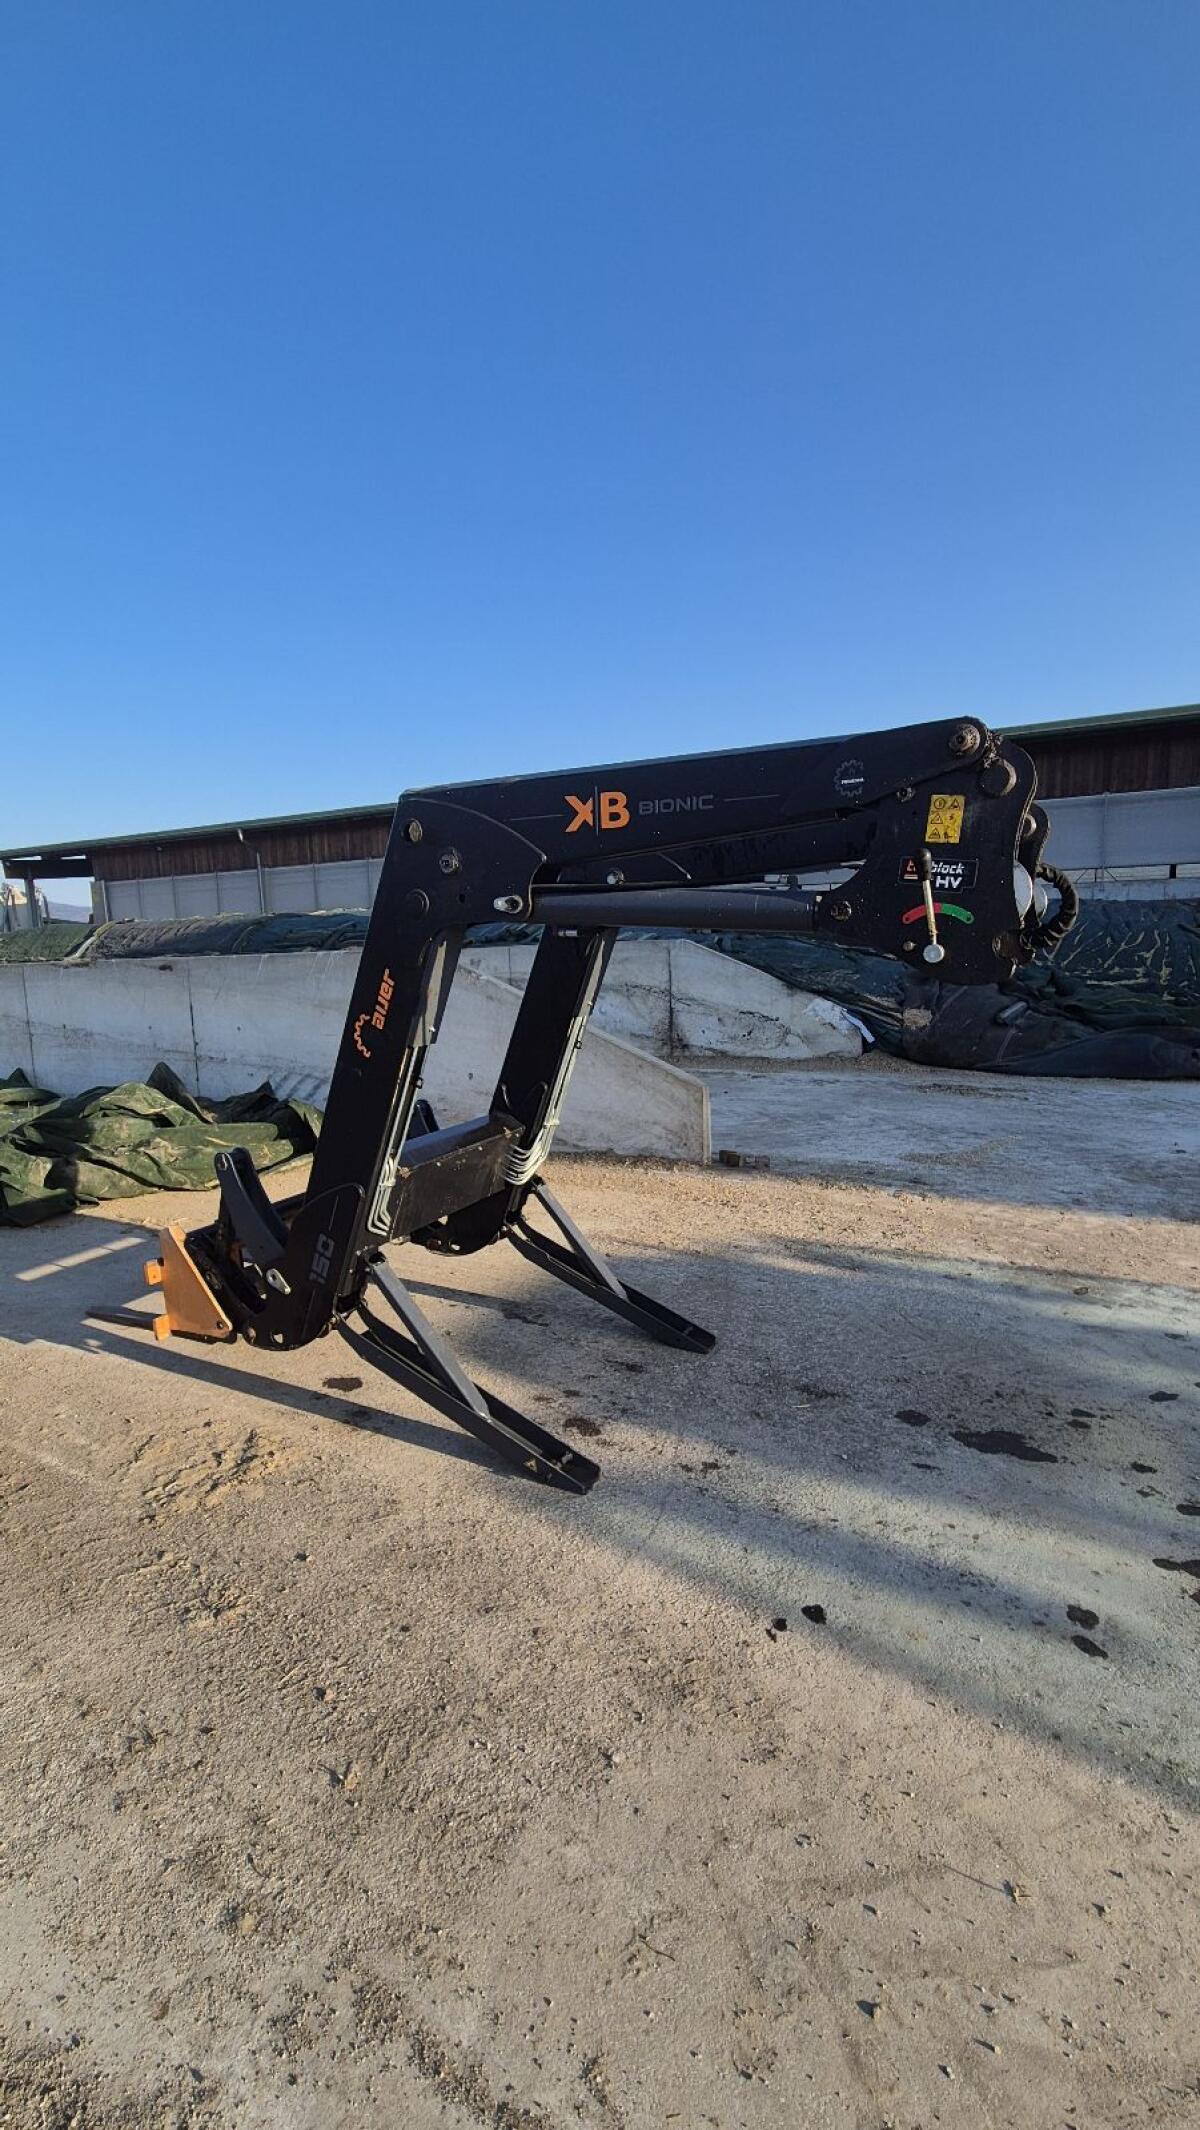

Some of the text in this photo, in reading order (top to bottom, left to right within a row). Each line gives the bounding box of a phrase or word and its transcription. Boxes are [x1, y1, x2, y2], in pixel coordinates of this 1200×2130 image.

[639, 794, 714, 816] BIONIC
[935, 875, 962, 889] HV
[371, 967, 395, 1030] auer
[309, 1233, 335, 1284] 150
